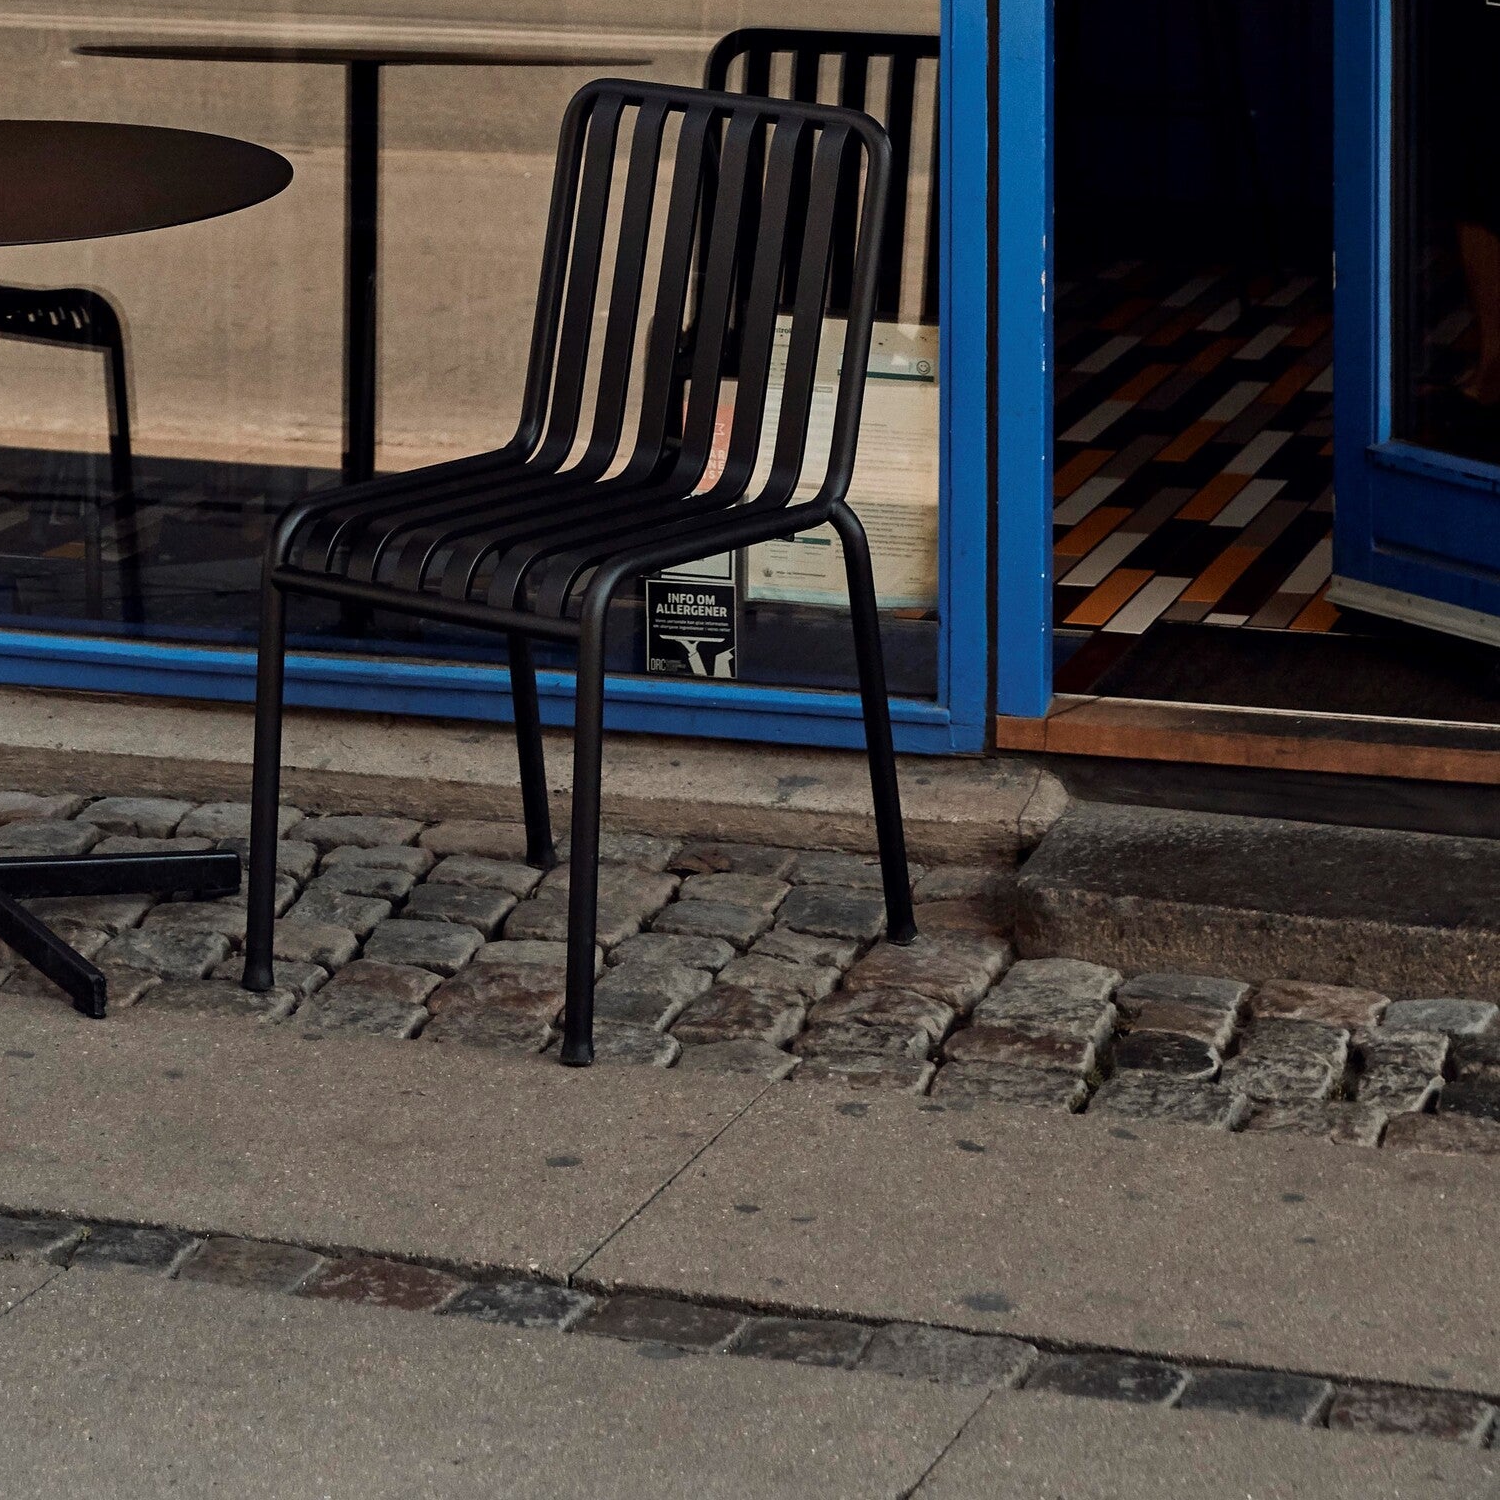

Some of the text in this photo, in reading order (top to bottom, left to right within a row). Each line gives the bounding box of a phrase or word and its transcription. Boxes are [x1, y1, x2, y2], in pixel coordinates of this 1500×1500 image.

[667, 592, 716, 606] INFO OM
[655, 603, 728, 618] ALLERGENER
